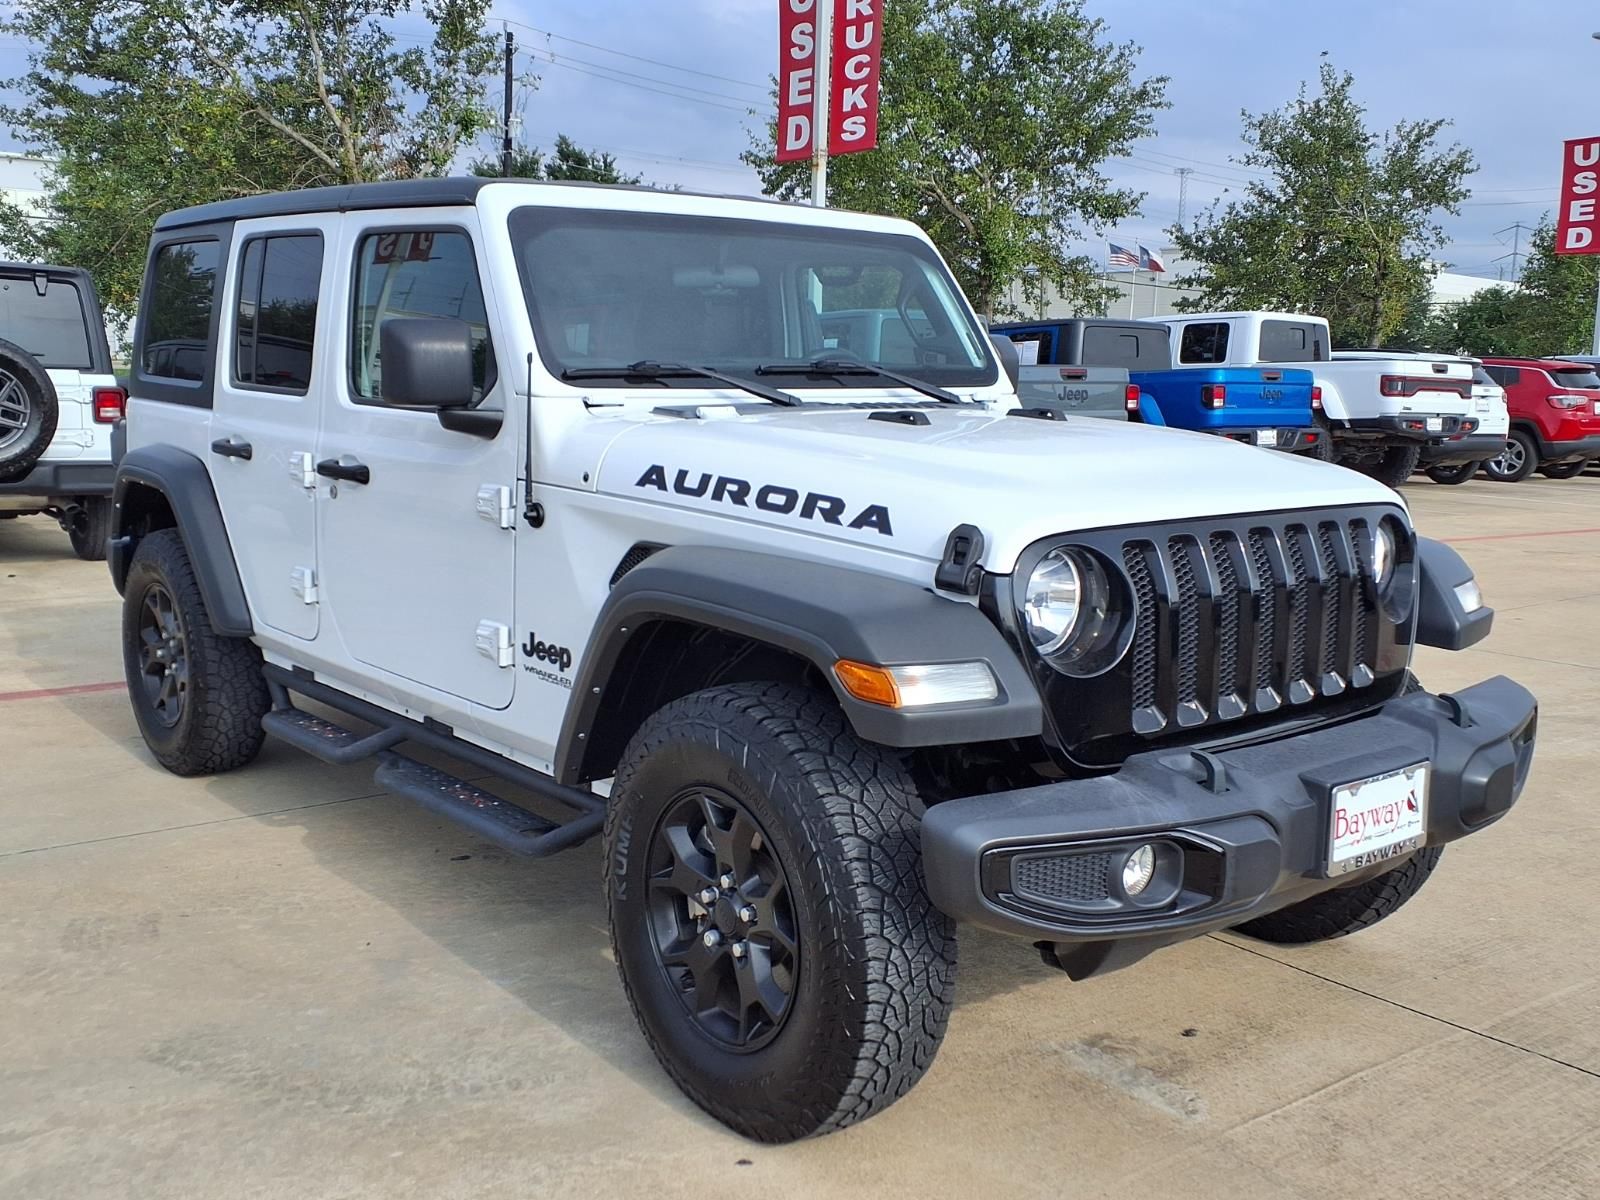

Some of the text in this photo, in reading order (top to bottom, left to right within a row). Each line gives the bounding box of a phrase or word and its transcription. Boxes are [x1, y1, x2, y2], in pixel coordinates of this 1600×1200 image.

[1565, 142, 1600, 249] USED
[1057, 385, 1089, 403] Jeep
[1259, 385, 1283, 402] Jeep
[635, 464, 893, 536] AURORA
[522, 631, 572, 672] Jeep
[1334, 799, 1405, 844] Bayway
[612, 794, 640, 902] KUMH
[1355, 841, 1405, 868] BAYWAY
